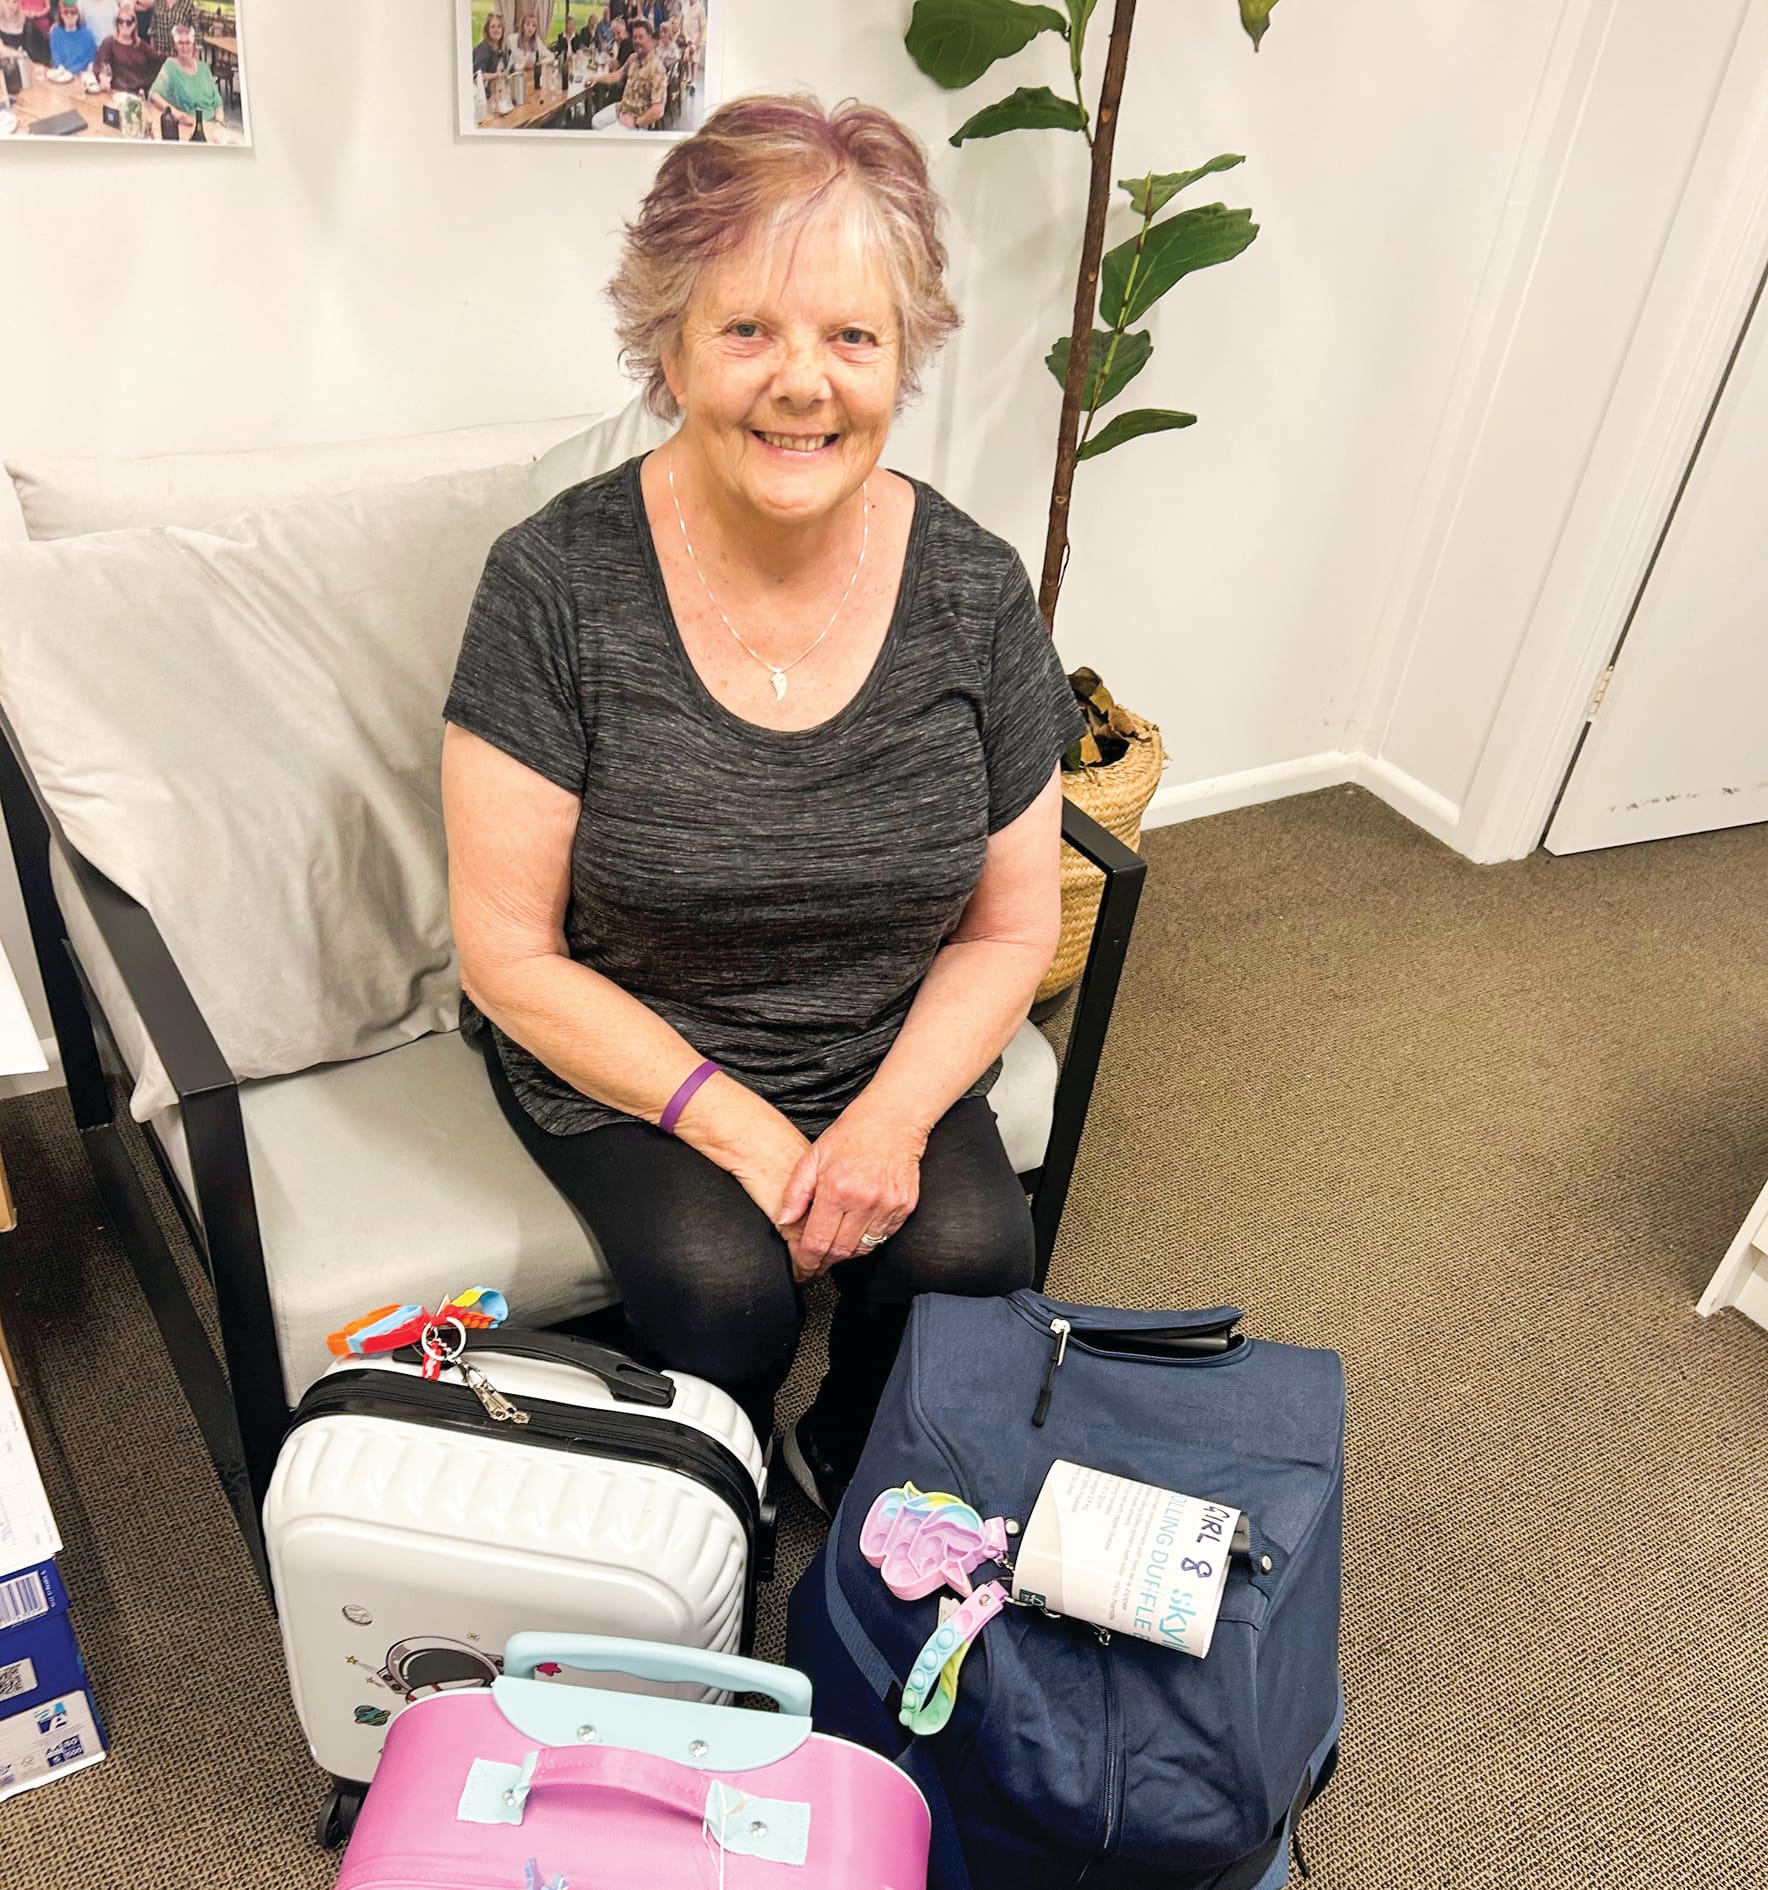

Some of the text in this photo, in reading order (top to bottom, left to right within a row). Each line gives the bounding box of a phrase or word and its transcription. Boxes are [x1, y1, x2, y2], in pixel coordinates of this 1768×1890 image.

[1181, 1506, 1230, 1578] GIRL 8
[1133, 1549, 1169, 1632] DUFFLE
